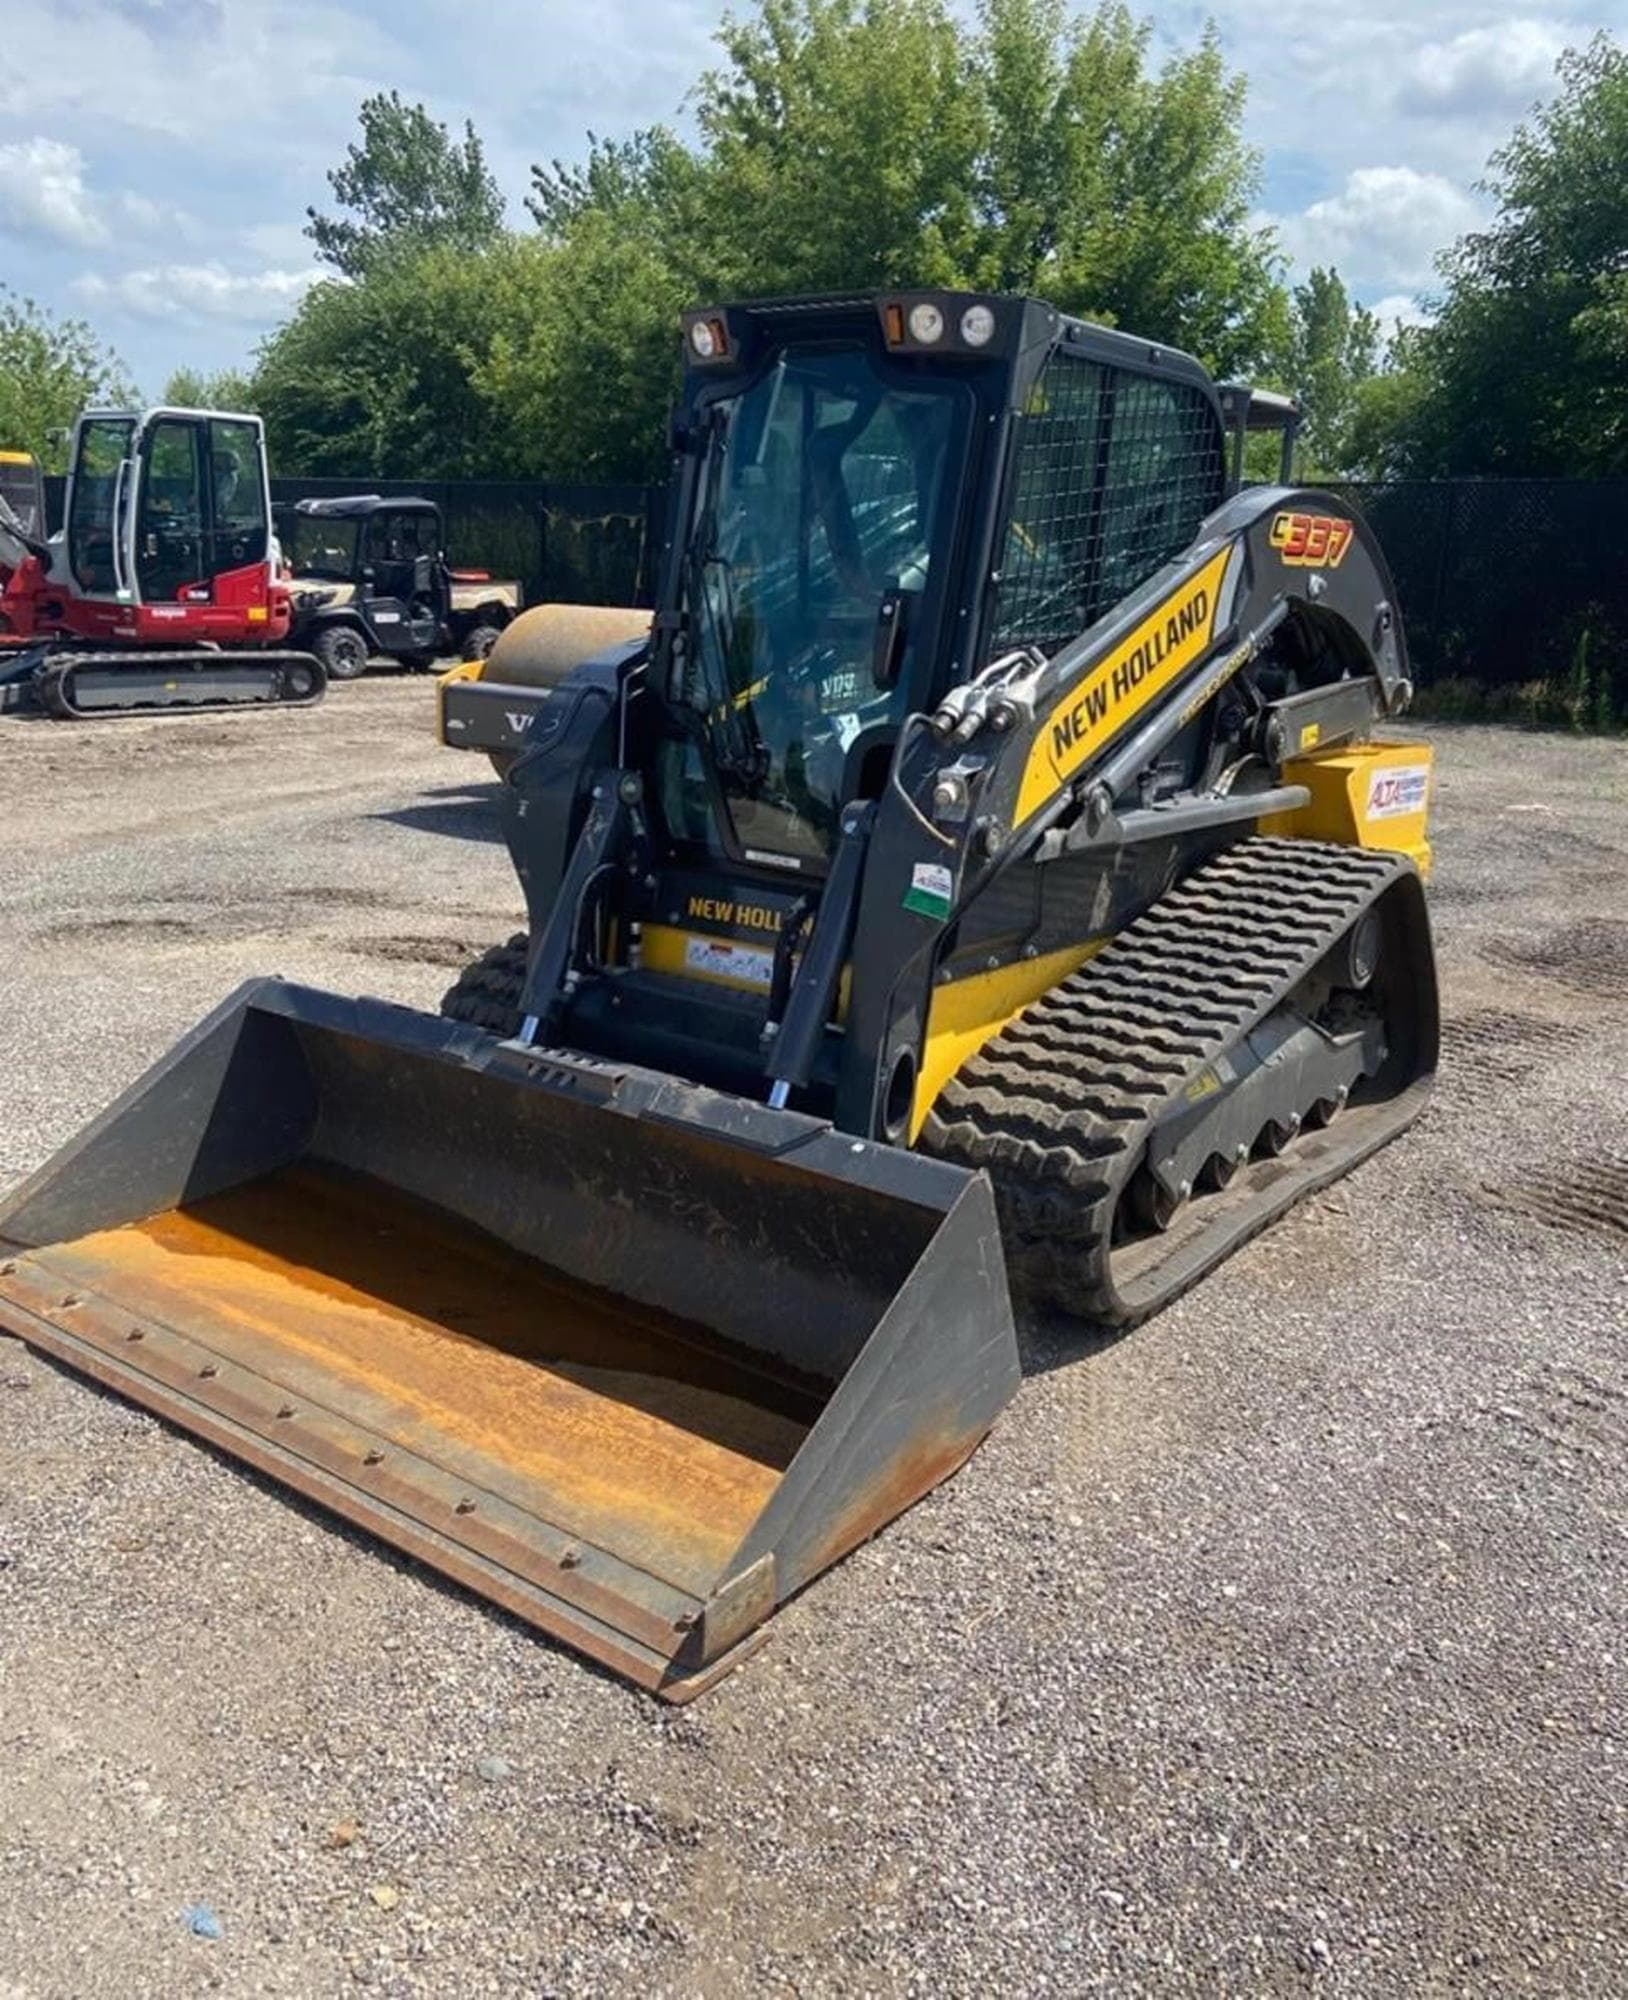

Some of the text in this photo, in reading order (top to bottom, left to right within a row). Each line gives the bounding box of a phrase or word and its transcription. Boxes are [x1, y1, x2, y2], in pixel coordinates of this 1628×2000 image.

[1270, 513, 1352, 567] C337
[1053, 680, 1107, 759] NEW
[1111, 590, 1208, 704] HOLLAND
[688, 897, 813, 936] NEW HOLLN
